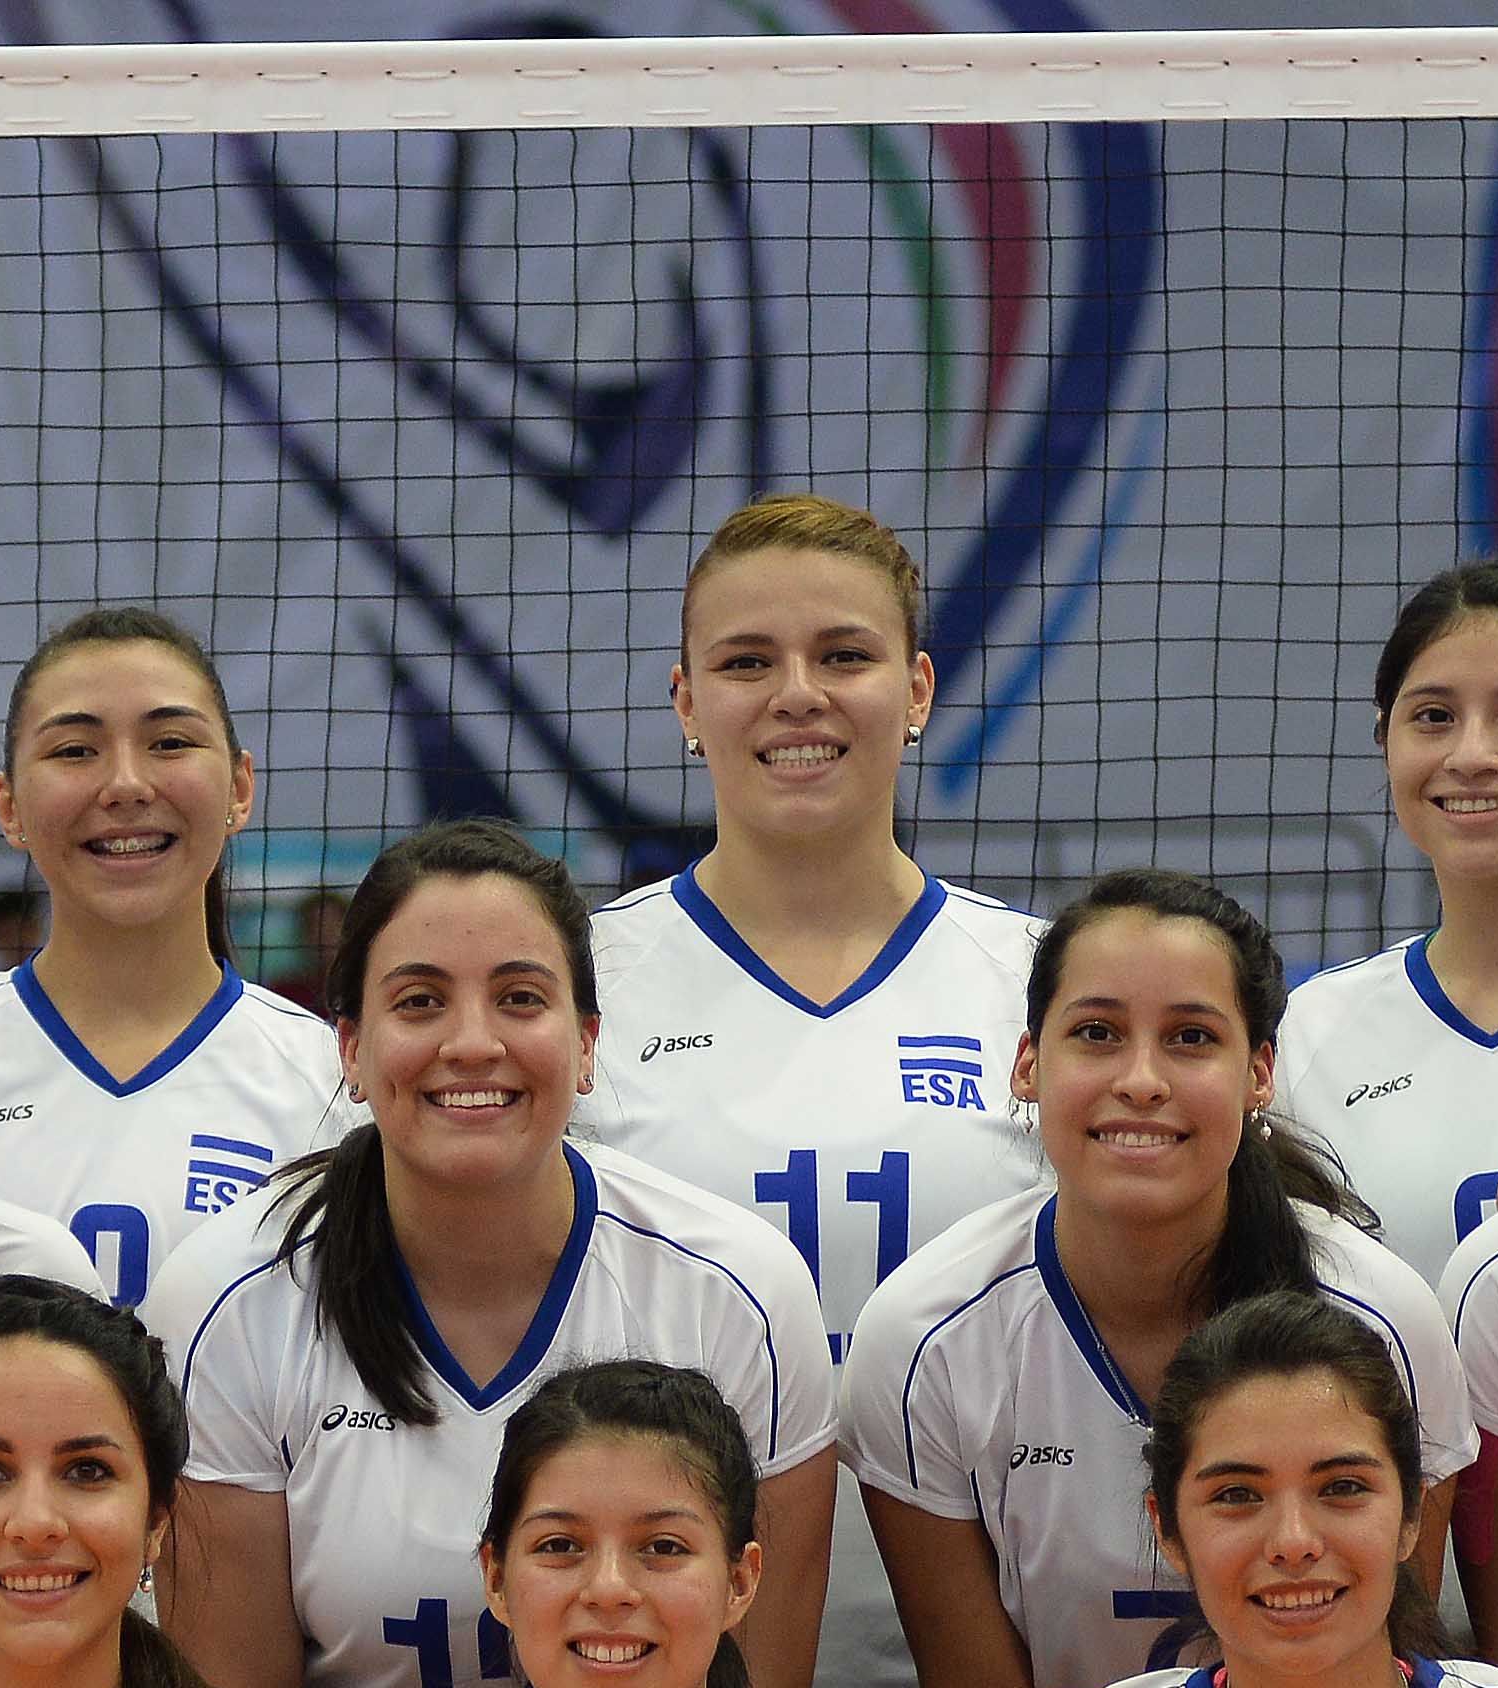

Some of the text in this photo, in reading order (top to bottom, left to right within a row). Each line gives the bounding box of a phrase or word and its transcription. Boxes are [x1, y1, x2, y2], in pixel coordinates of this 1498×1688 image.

[662, 1031, 714, 1053] asics
[901, 1072, 987, 1112] ESA
[1367, 1072, 1413, 1101] asics
[184, 1176, 259, 1215] ES
[754, 1149, 910, 1365] 11
[347, 1408, 397, 1433] asics
[1029, 1445, 1075, 1468] asics
